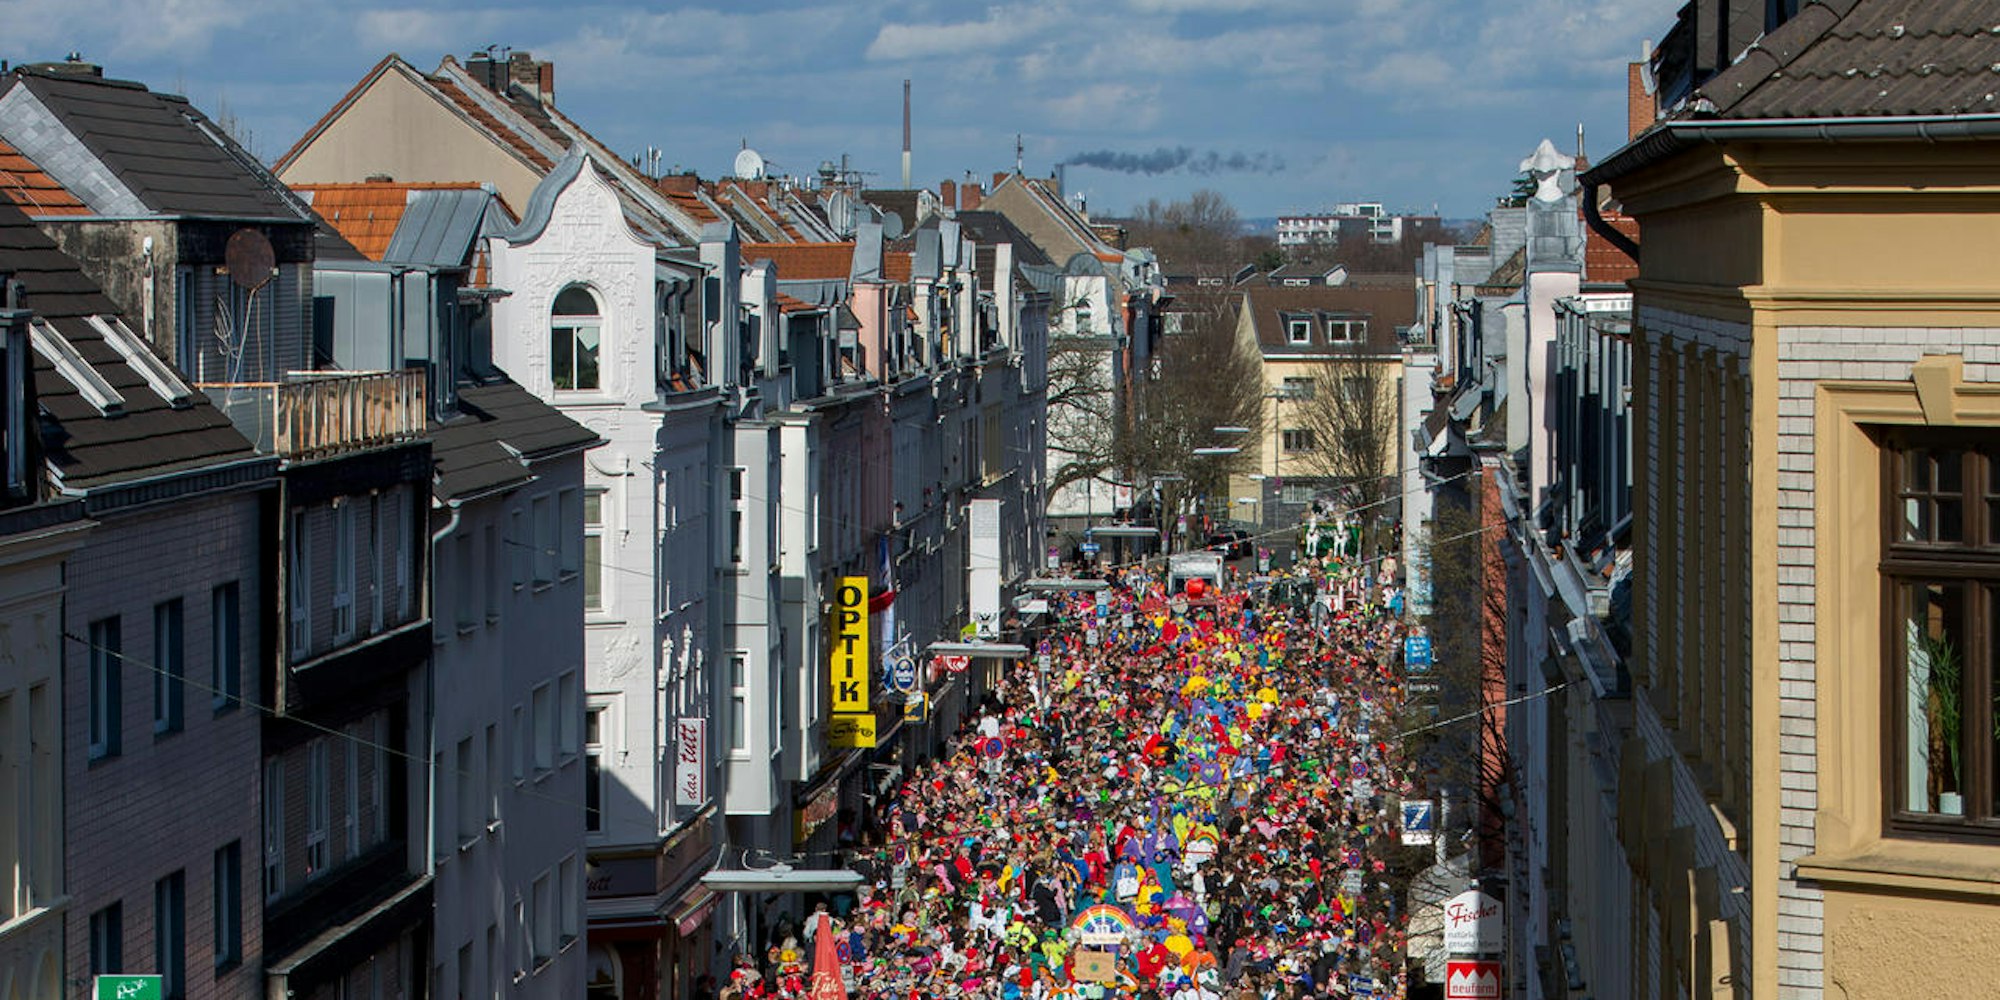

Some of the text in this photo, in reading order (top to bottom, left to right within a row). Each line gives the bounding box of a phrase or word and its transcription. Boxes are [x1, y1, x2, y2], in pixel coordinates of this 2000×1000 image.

[837, 586, 862, 702] OPTIK
[680, 723, 697, 800] das tutt
[1447, 901, 1497, 928] Fischer
[1452, 983, 1495, 993] neuform
